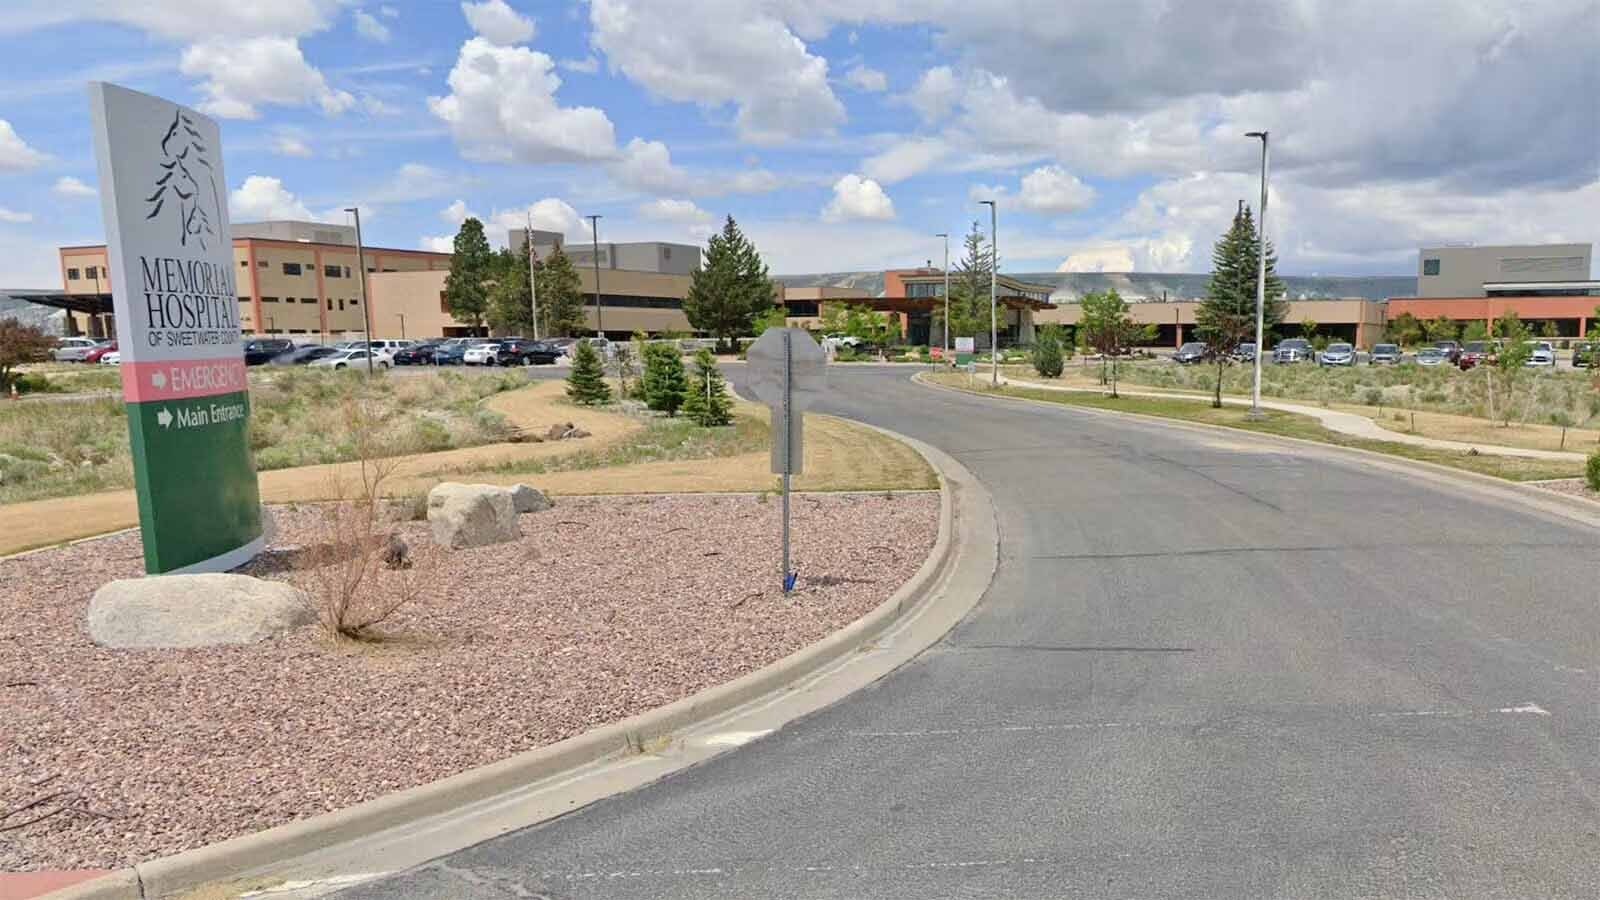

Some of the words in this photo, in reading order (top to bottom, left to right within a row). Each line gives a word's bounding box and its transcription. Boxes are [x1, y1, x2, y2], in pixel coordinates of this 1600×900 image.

[140, 256, 235, 297] MEMORIAL
[145, 293, 238, 329] HOSPITAL
[148, 331, 163, 346] OF
[170, 363, 242, 392] EMERGENC
[177, 406, 209, 429] Main
[210, 403, 245, 424] Entrance
